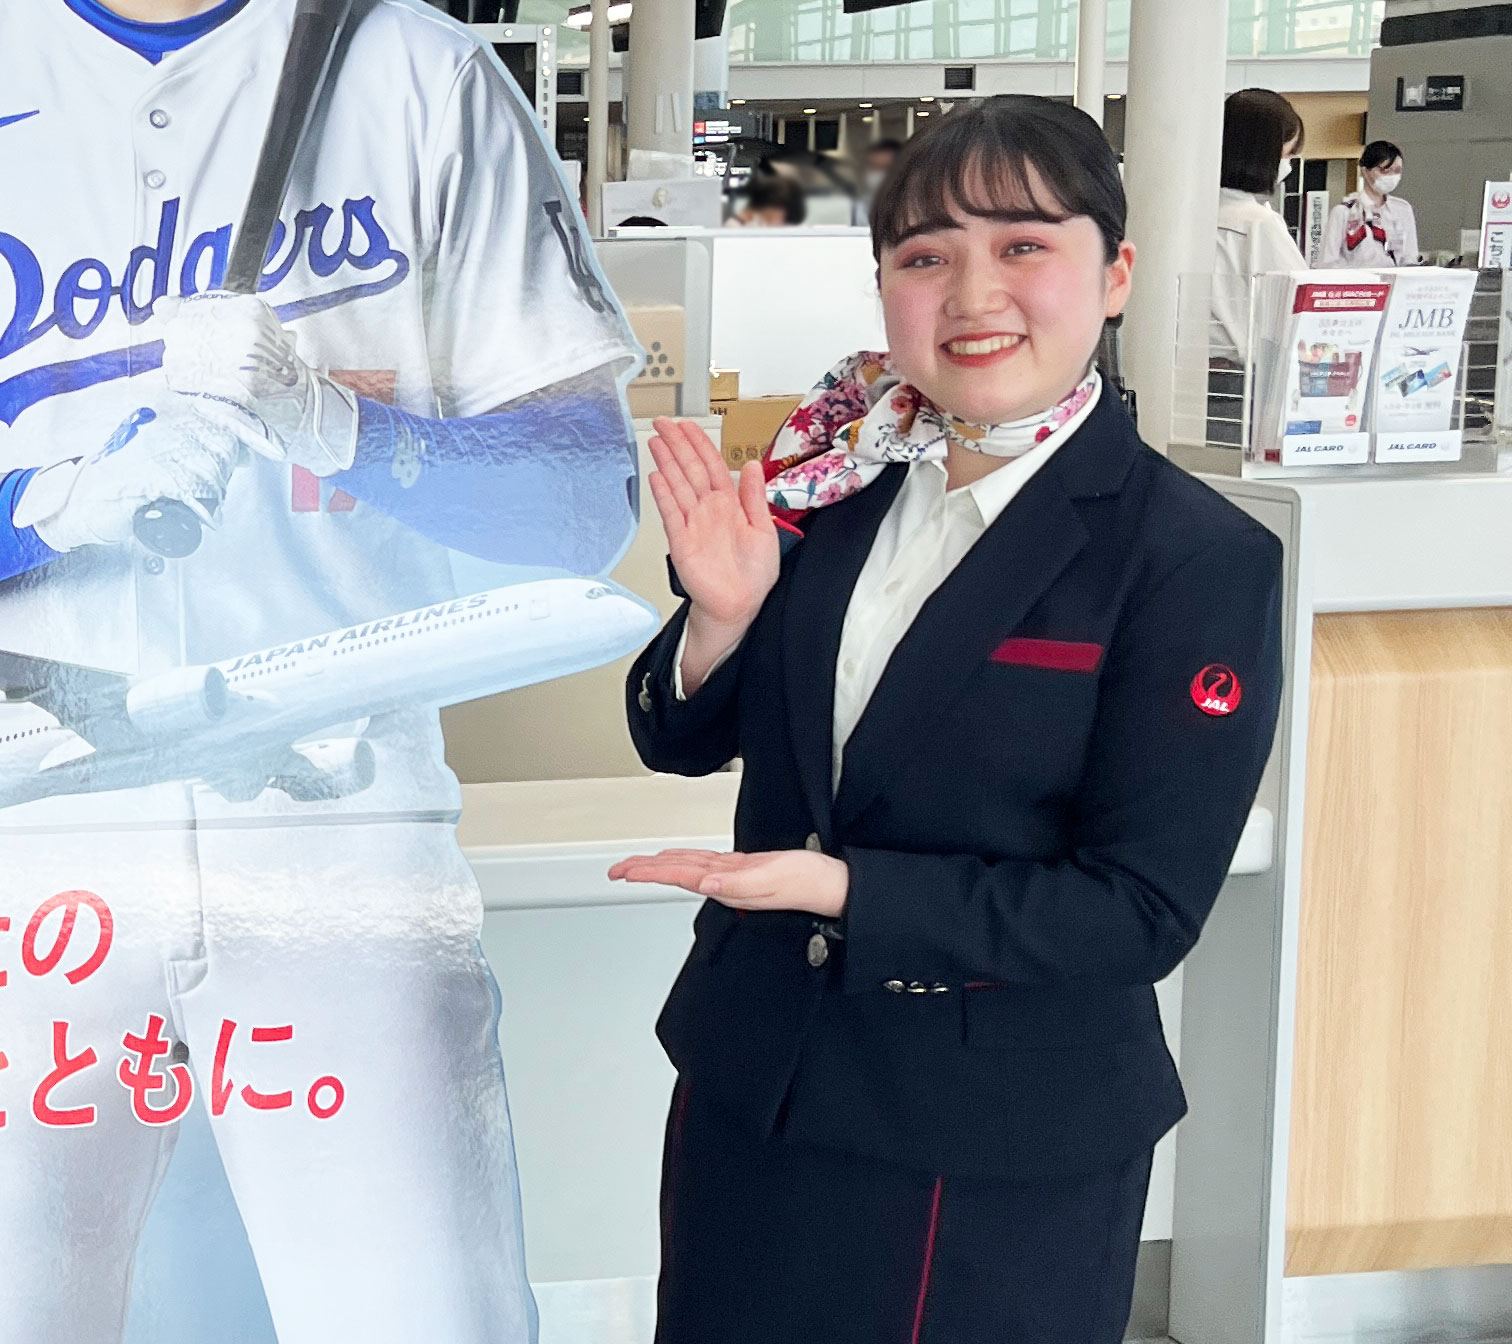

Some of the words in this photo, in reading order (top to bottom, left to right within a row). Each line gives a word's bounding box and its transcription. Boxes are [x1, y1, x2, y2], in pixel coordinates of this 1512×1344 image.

[1398, 307, 1454, 329] JMB
[1407, 442, 1437, 450] CARD
[227, 635, 330, 673] JAPAN
[337, 594, 489, 644] AIRLINES
[1200, 697, 1230, 712] JAL
